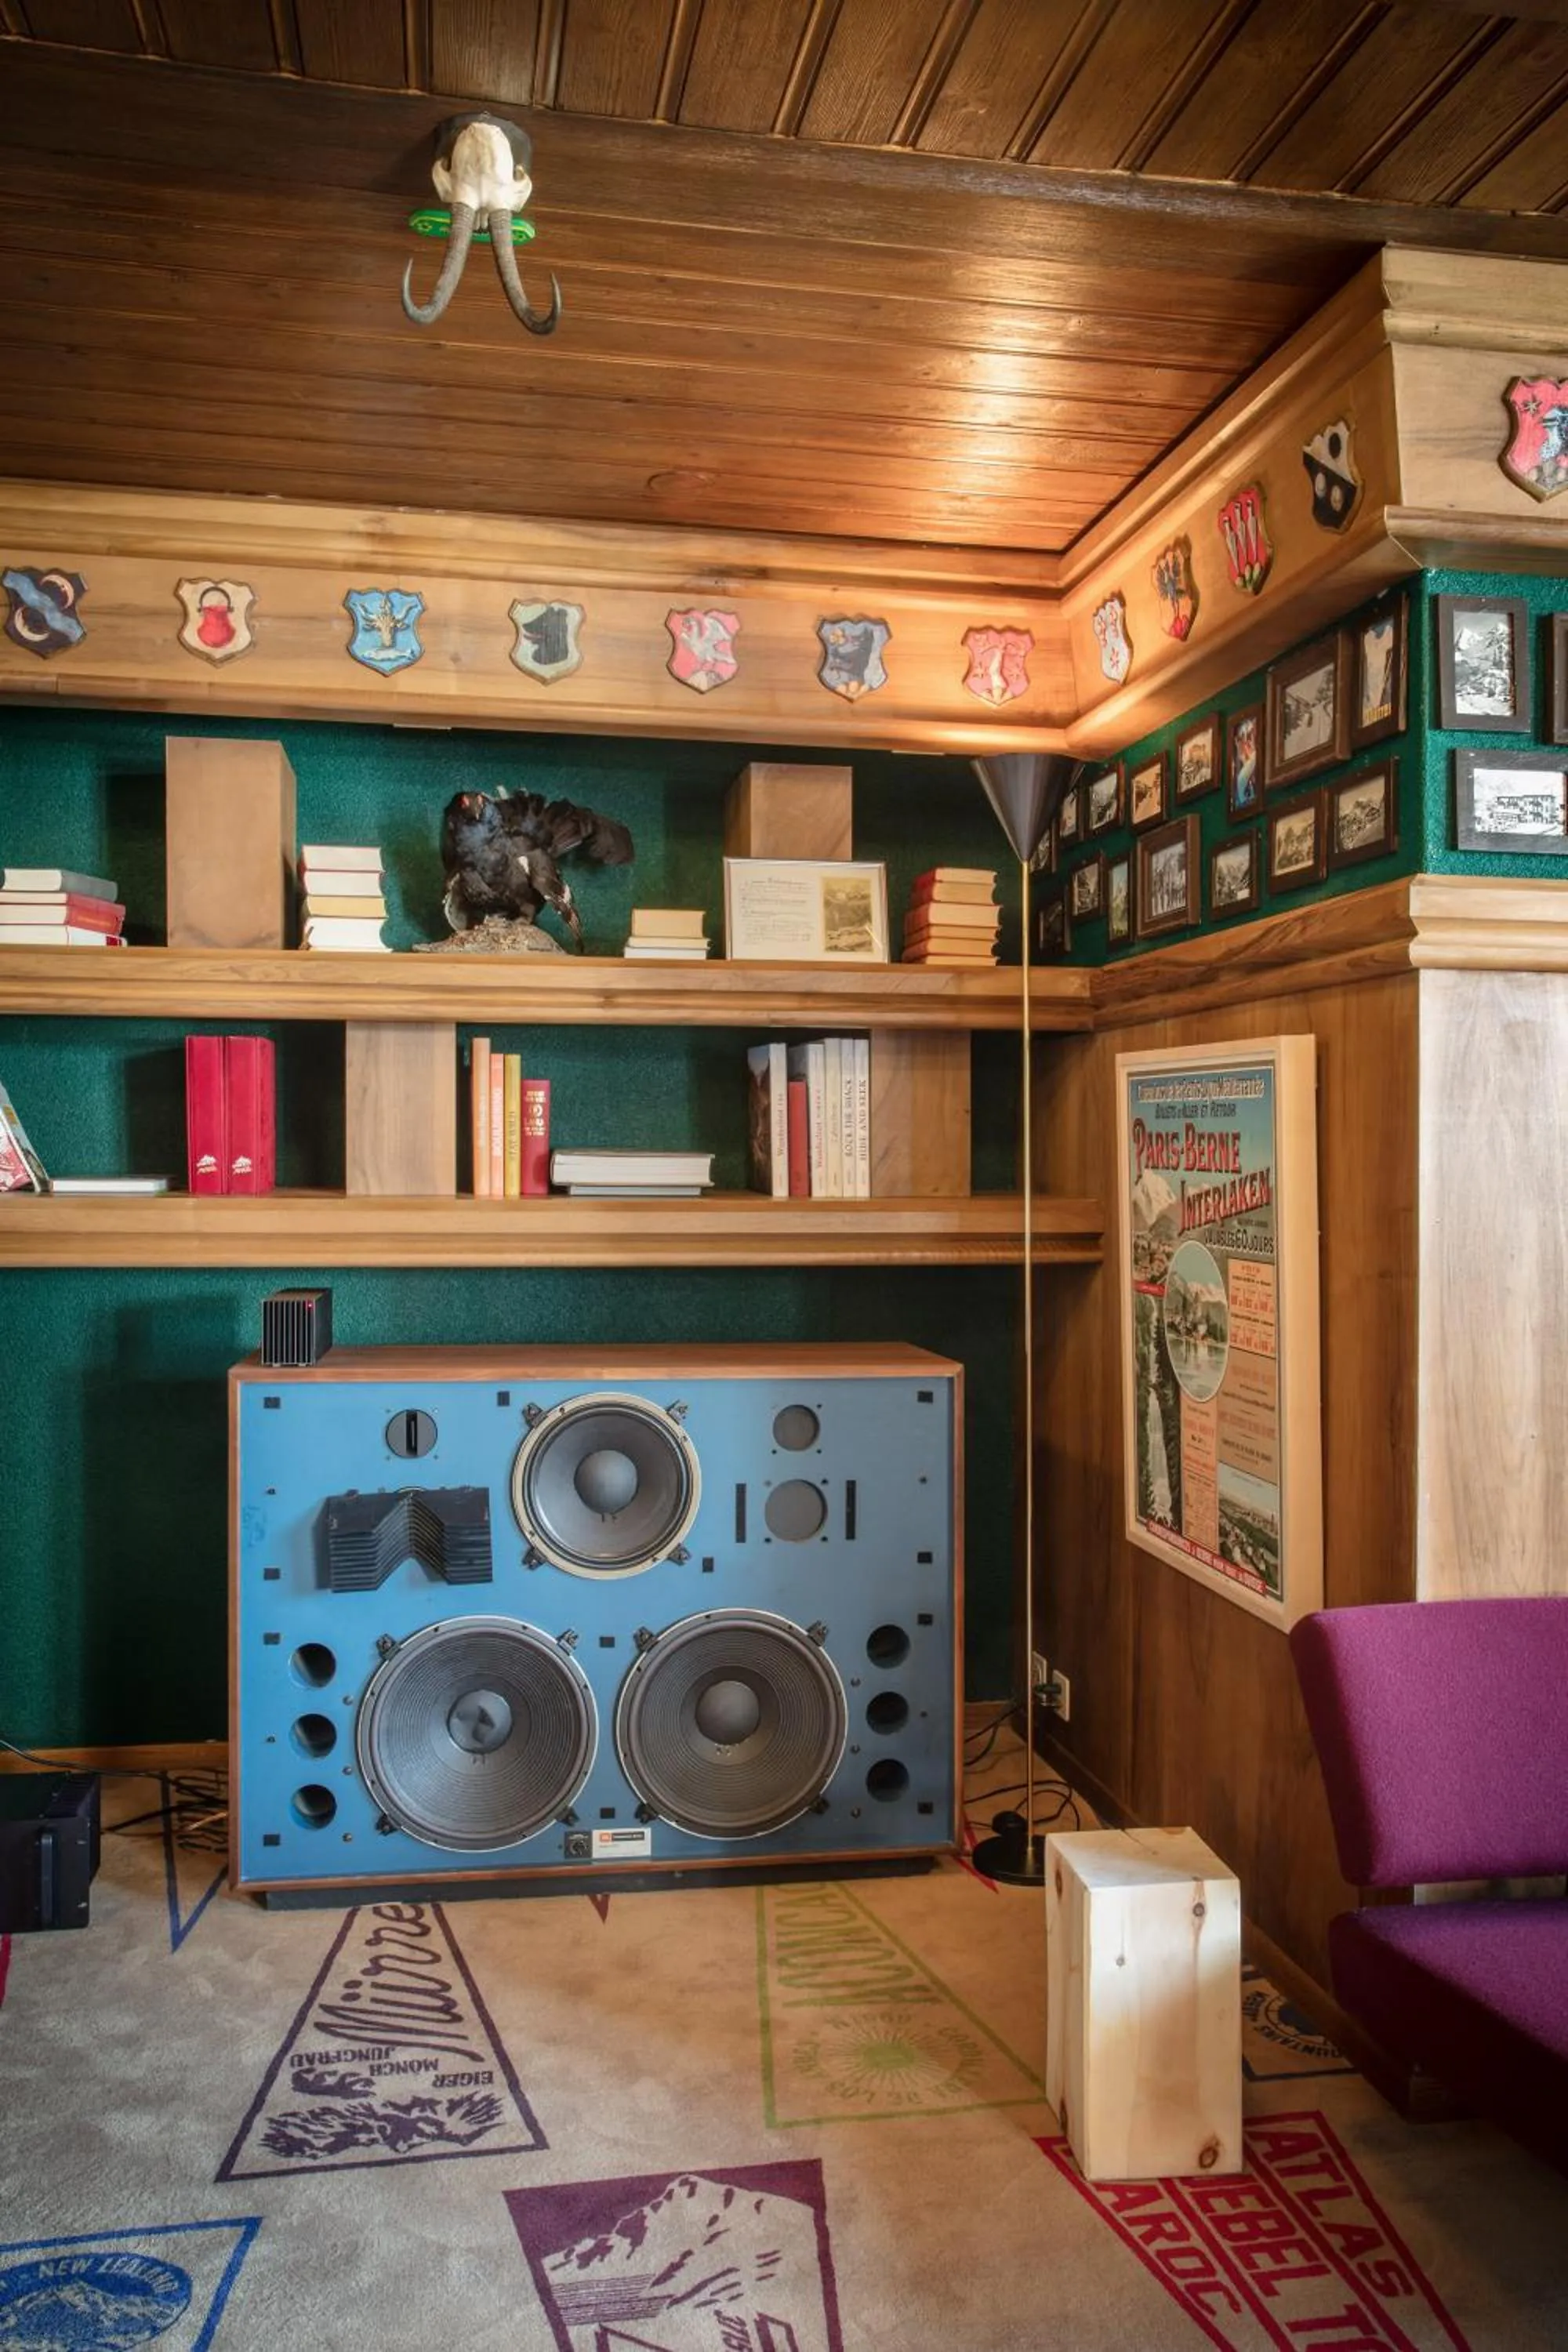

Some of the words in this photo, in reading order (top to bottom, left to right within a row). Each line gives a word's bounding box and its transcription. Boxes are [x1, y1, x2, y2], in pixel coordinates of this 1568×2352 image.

[1178, 1166, 1272, 1236] INTERLAKEN
[289, 2044, 392, 2070] JUNGFRAU
[431, 2070, 495, 2089] EIGER
[1244, 2130, 1415, 2298] ATLAS
[39, 2257, 94, 2278] NEW
[1091, 2183, 1243, 2317] AROC
